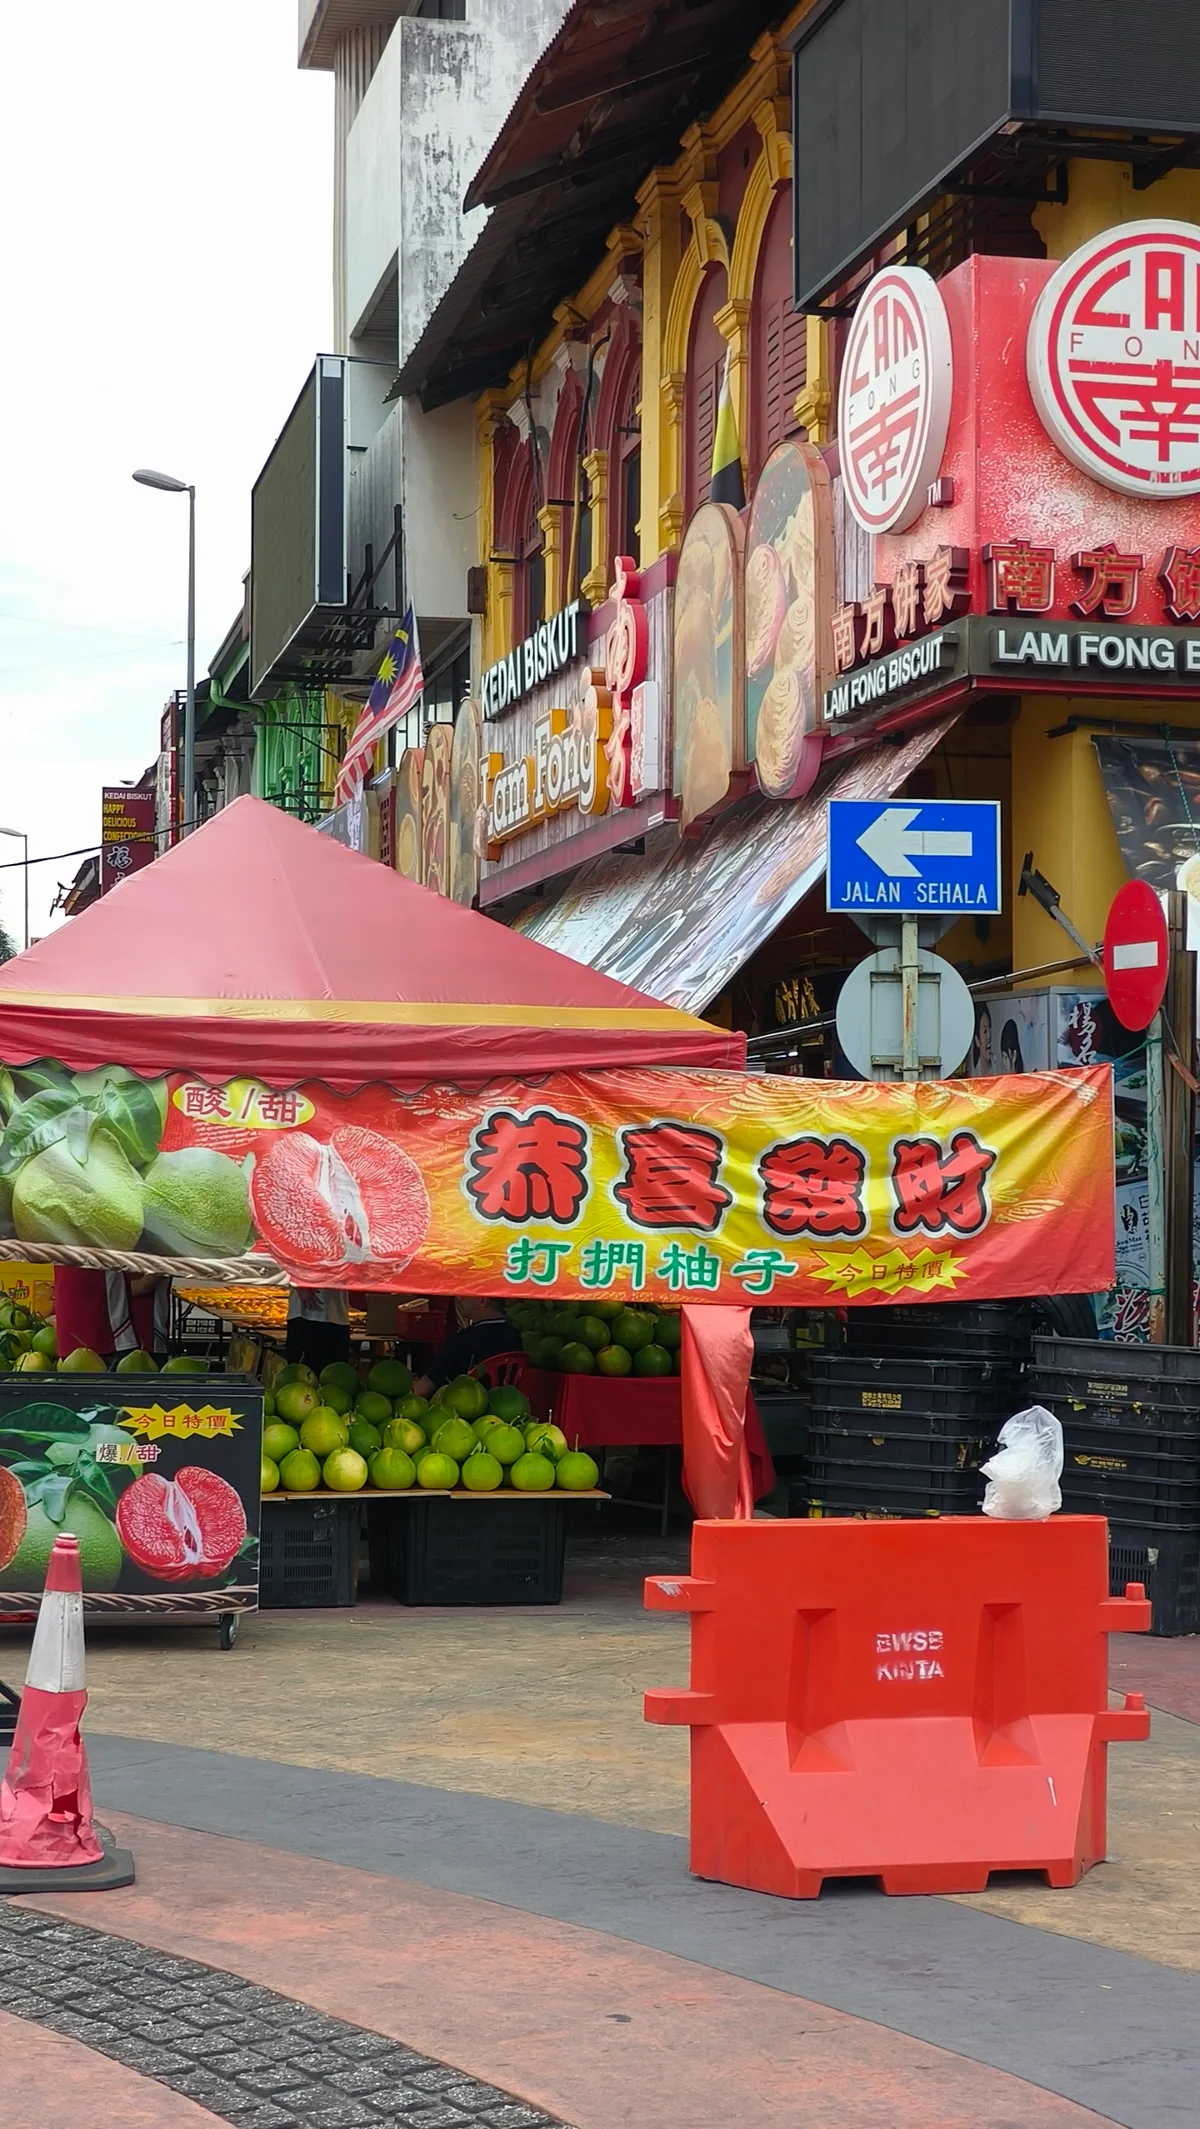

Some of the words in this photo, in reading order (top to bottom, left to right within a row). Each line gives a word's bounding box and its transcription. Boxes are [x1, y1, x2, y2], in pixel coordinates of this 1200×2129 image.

[850, 295, 918, 397] LAM
[849, 358, 921, 427] FONG
[482, 646, 522, 719] KEDAI
[525, 599, 580, 692] BISKUT
[999, 629, 1069, 664] LAM
[1080, 634, 1175, 670] FONG
[824, 683, 849, 719] LAM
[851, 665, 886, 708] FONG
[889, 635, 943, 690] BISCUIT
[104, 792, 126, 801] KEDAI
[127, 793, 153, 801] BISKUT
[480, 752, 530, 836] Lam
[534, 709, 599, 814] Fong
[103, 803, 125, 814] HAPPY
[103, 817, 136, 827] DELICIOUS
[841, 881, 901, 903] JALAN
[916, 883, 988, 904] SEHALA
[464, 1110, 997, 1238] 恭喜發財
[505, 1237, 797, 1294] 打捫柚子
[835, 1258, 945, 1282] 今日特價
[134, 1413, 228, 1430] 今日特價
